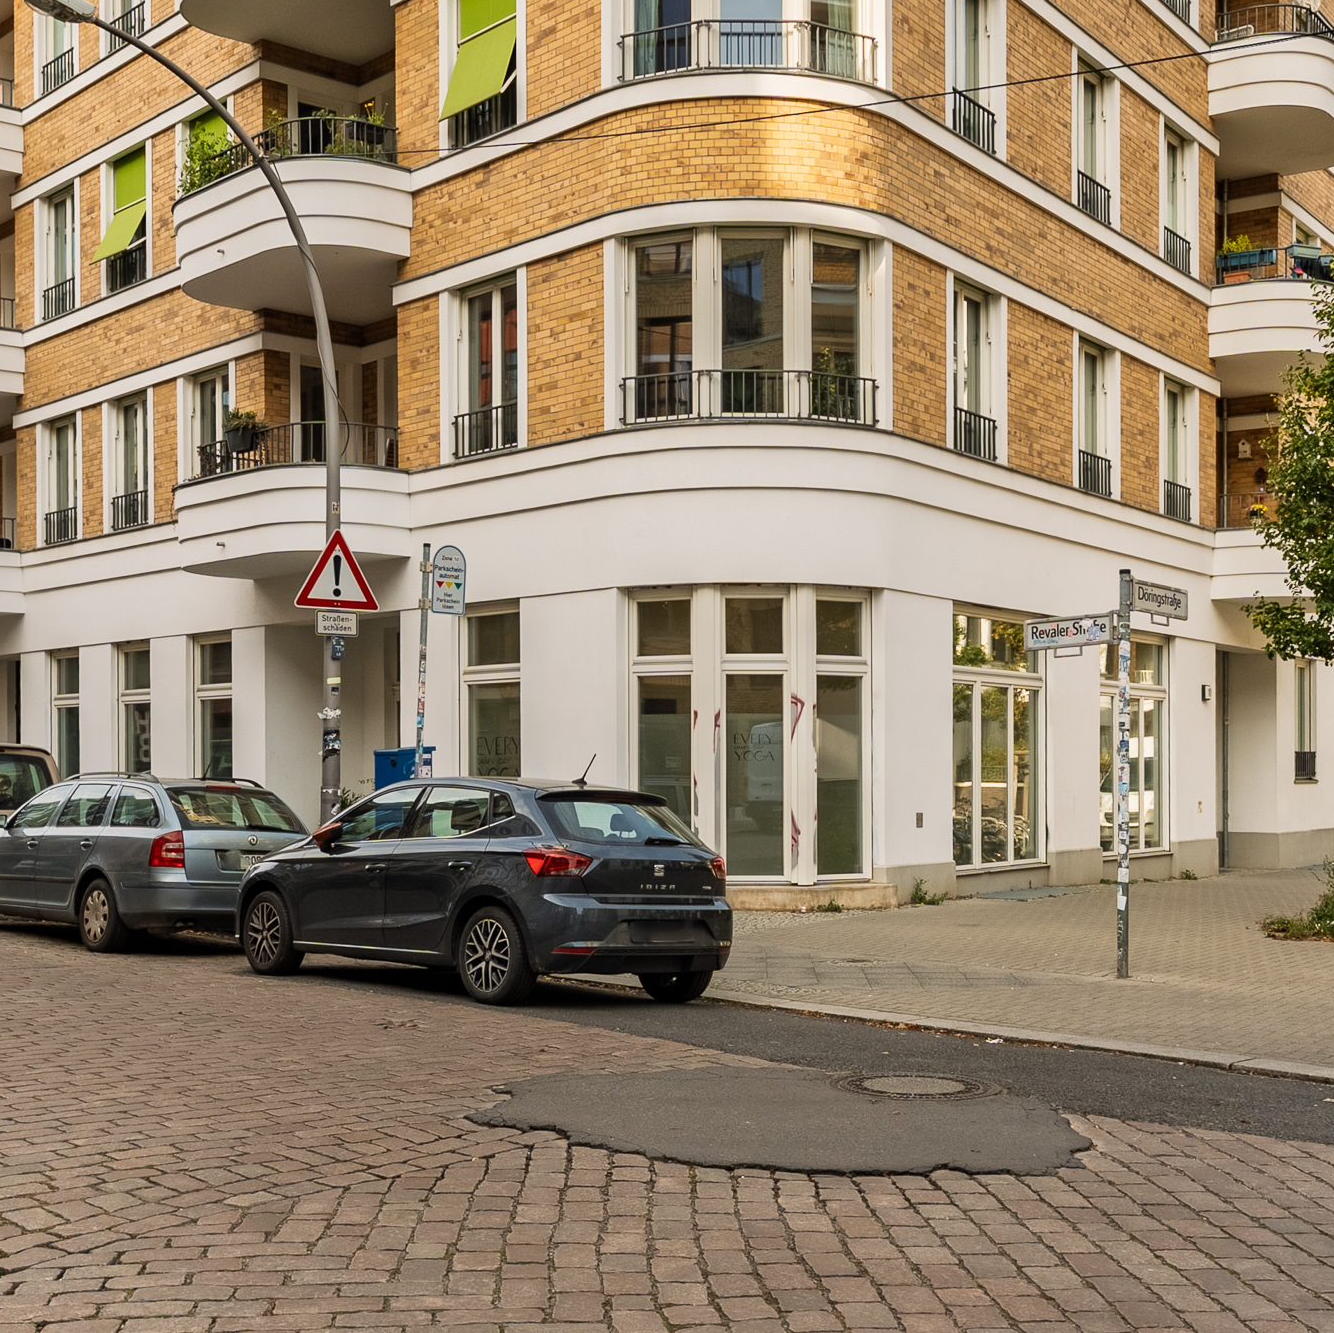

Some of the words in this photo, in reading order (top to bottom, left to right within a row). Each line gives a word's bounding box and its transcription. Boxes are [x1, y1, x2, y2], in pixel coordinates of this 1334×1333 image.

[1138, 586, 1181, 611] Döringstraße
[322, 615, 353, 623] Straßen-
[323, 623, 352, 632] schäden
[1032, 623, 1070, 640] Revaler
[733, 733, 774, 745] EVERY
[477, 736, 519, 756] EVERY
[734, 750, 776, 762] YOGA
